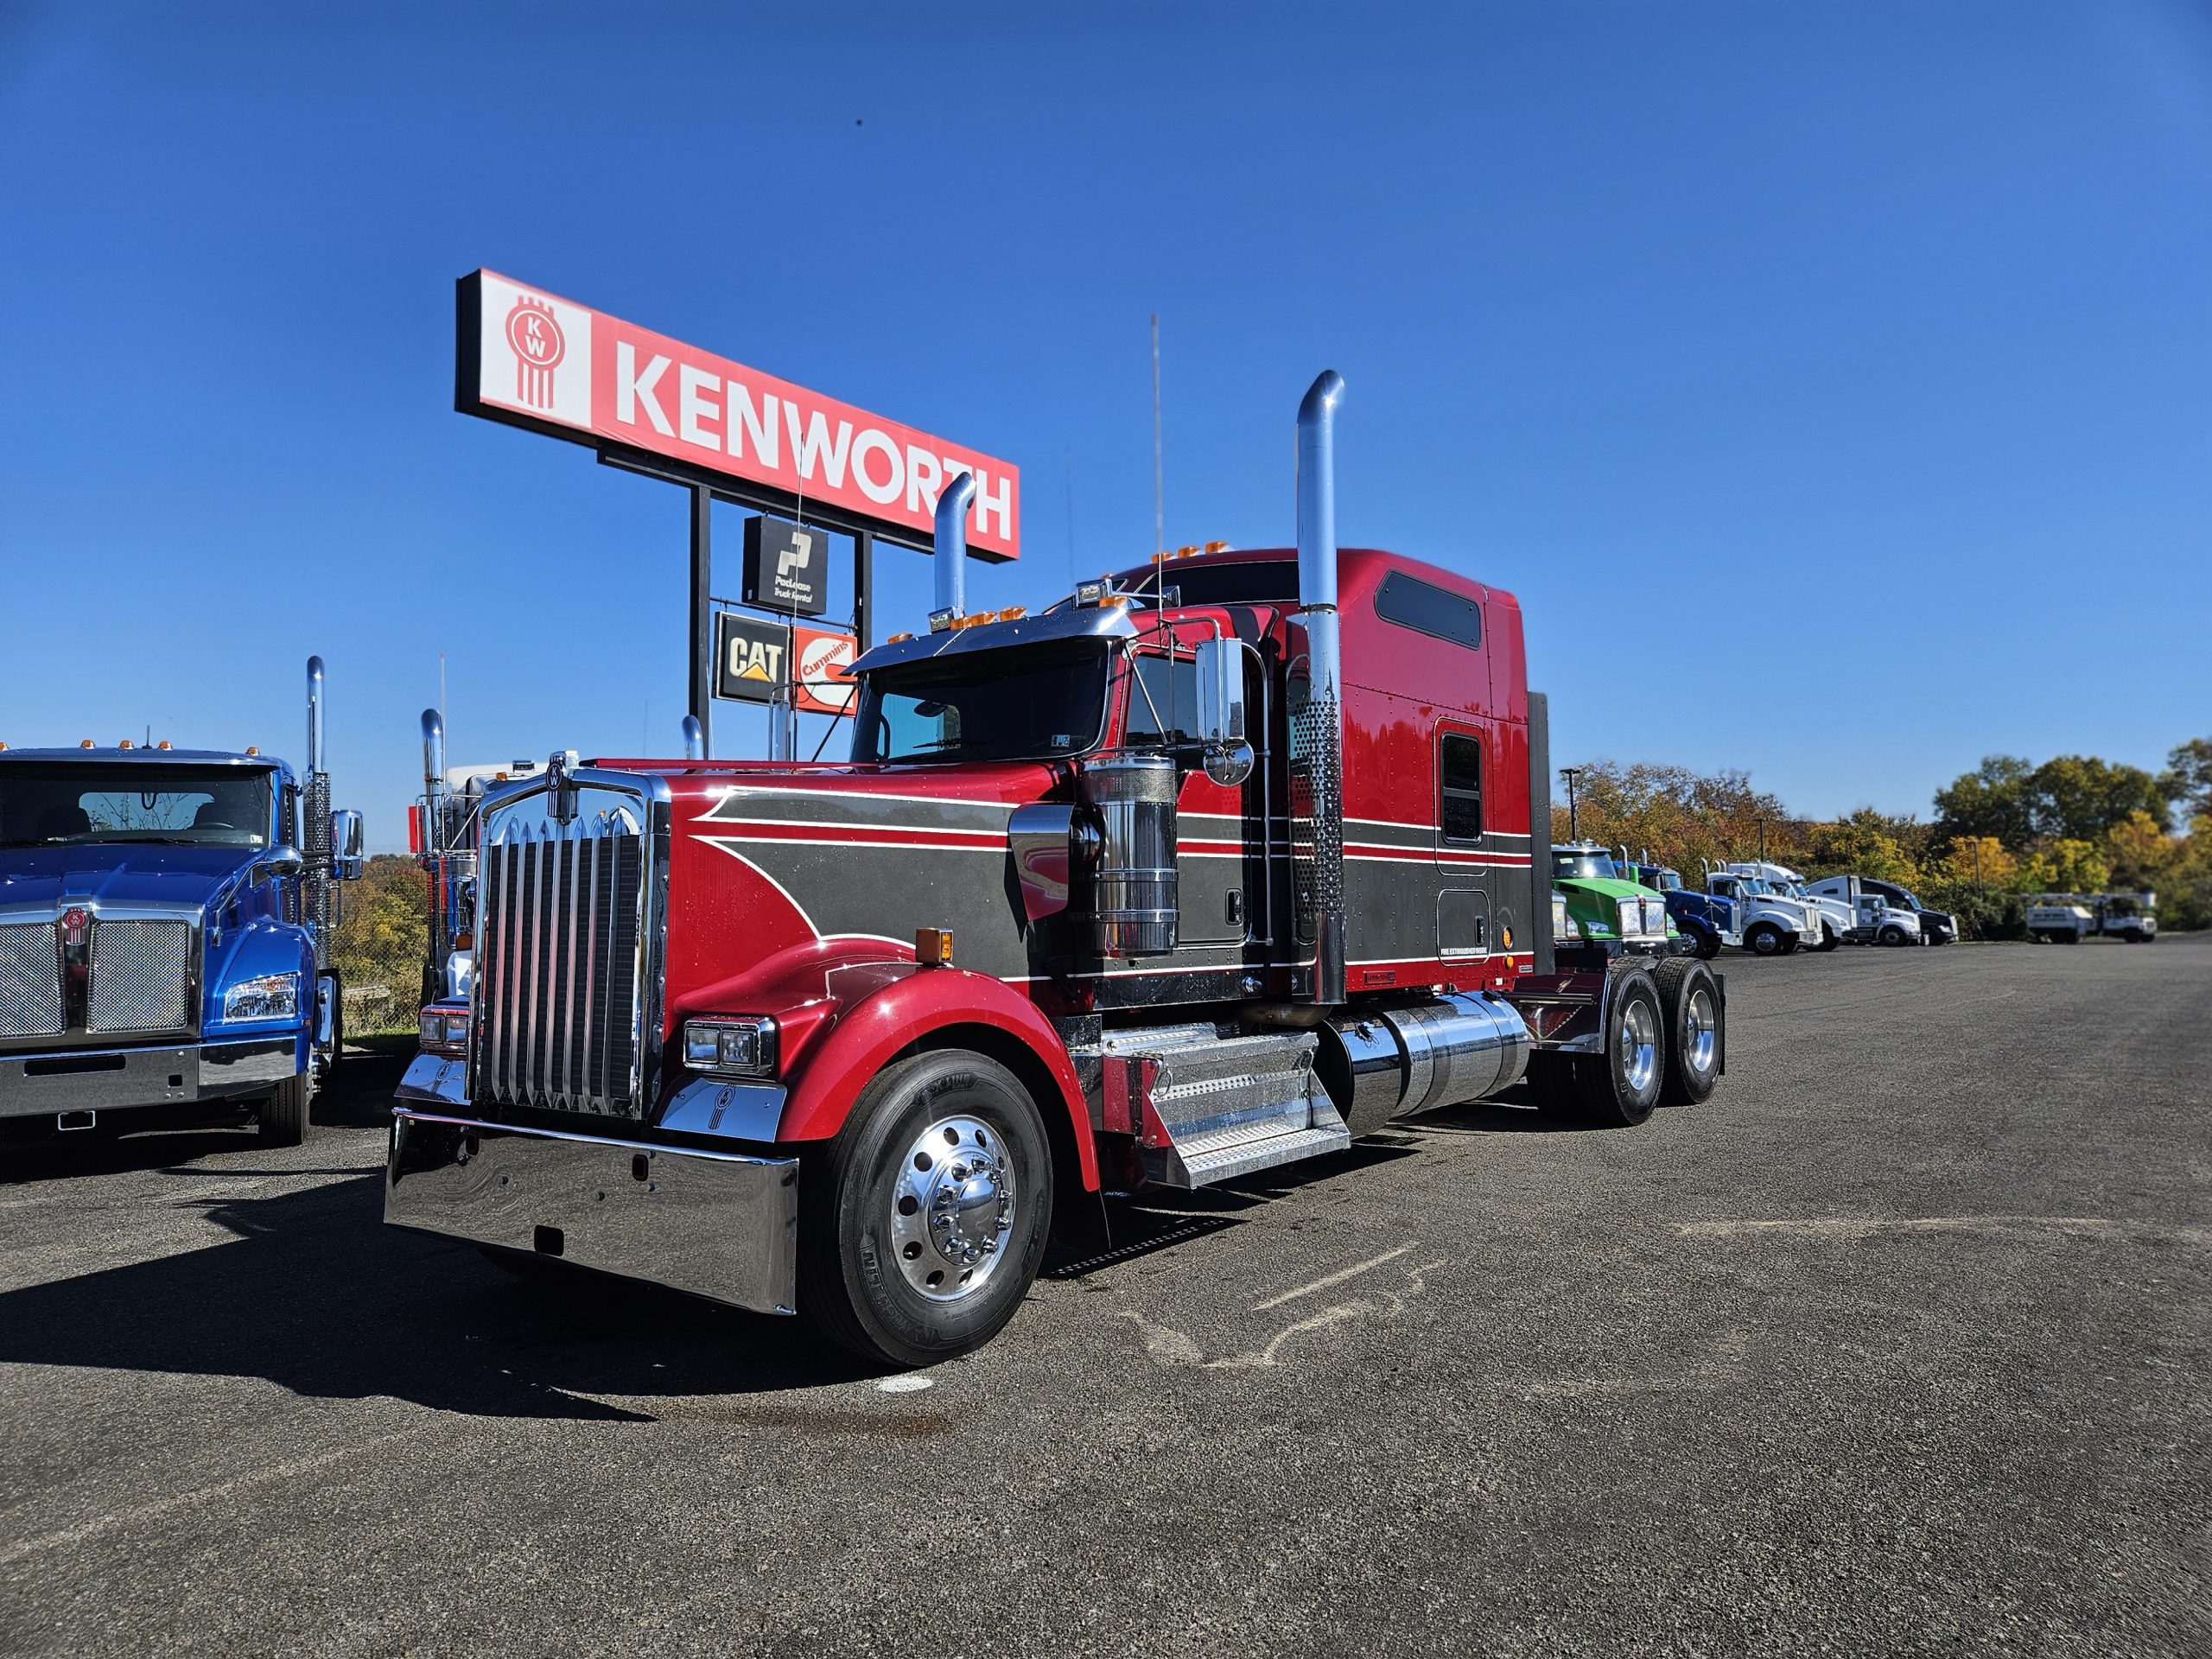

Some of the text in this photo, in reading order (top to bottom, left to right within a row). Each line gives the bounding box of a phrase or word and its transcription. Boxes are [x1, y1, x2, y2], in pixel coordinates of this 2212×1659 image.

[774, 587, 792, 599] Truck
[775, 575, 811, 593] PacLease
[729, 637, 784, 683] CAT
[802, 640, 849, 677] Cummins
